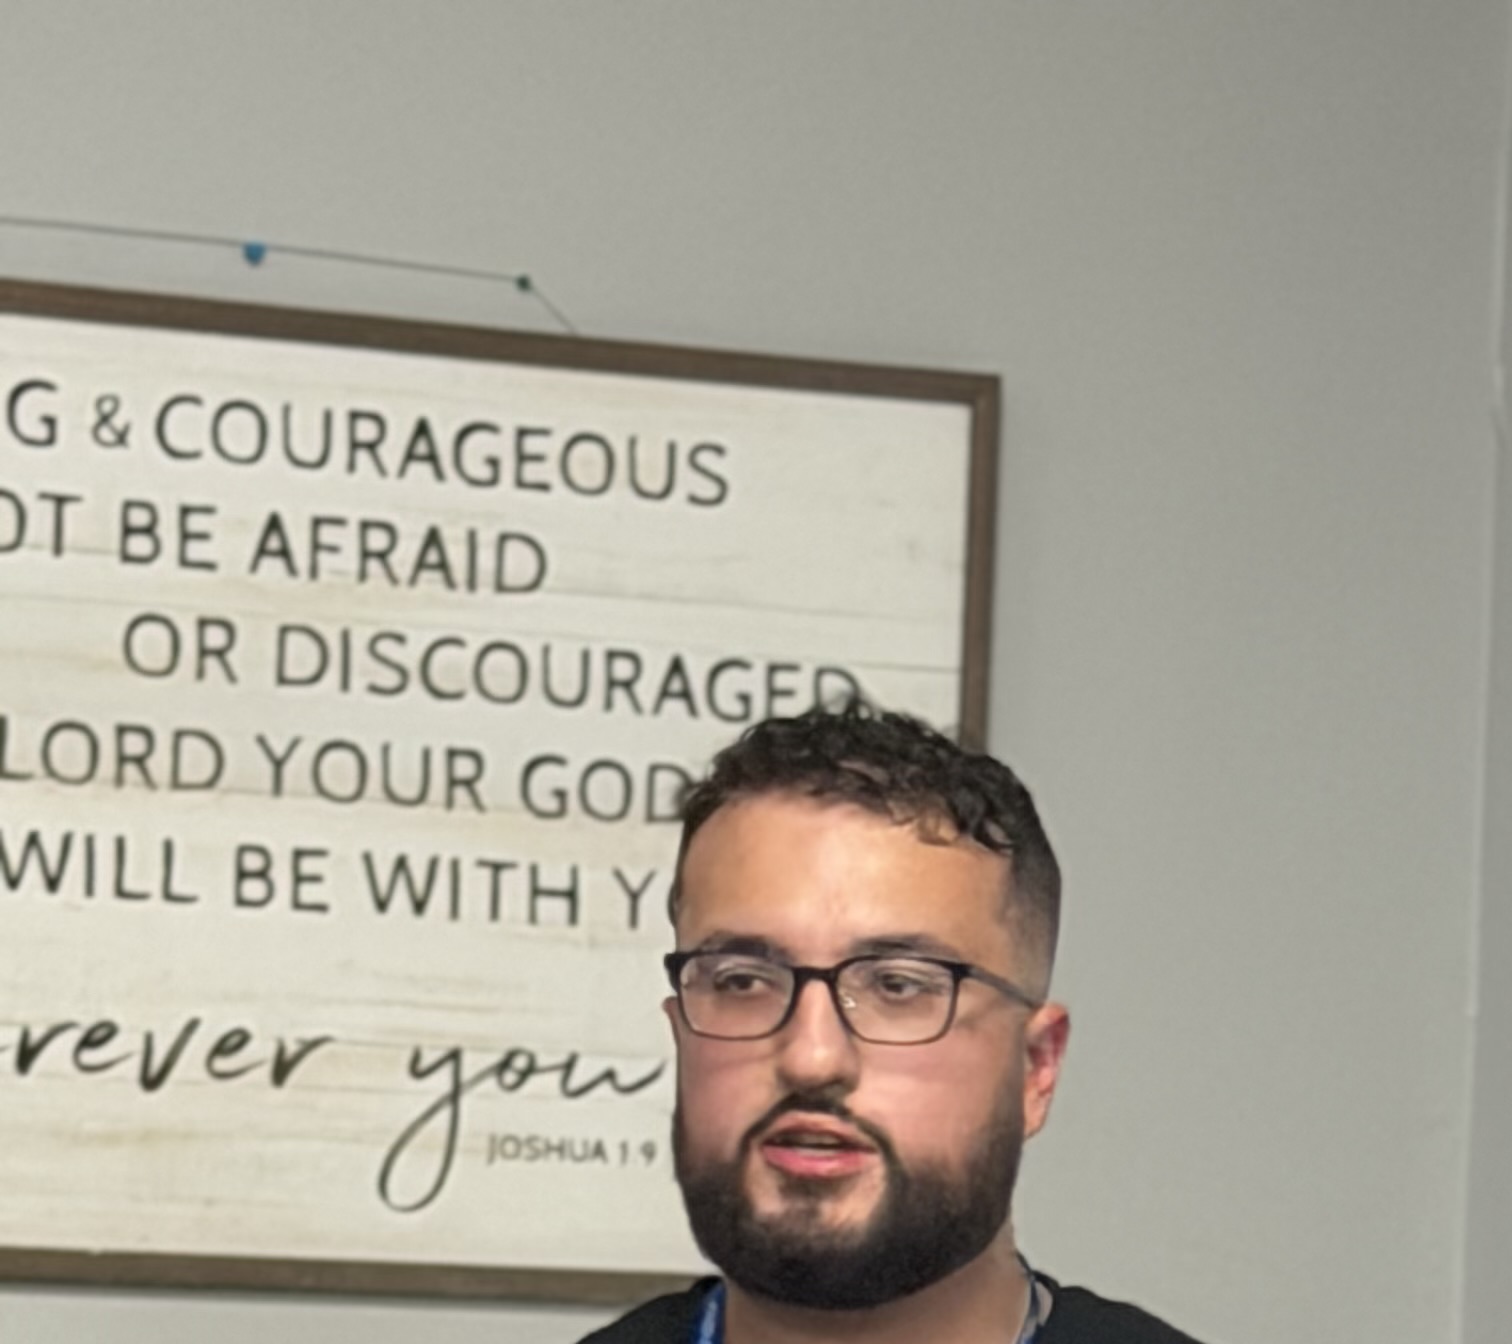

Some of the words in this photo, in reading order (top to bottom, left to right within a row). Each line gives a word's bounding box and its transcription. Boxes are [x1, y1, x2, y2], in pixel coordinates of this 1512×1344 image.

[91, 393, 131, 449] &
[154, 393, 729, 507] COURAGEOUS
[119, 498, 218, 572] BE
[248, 509, 547, 595] AFRAID
[122, 612, 238, 685] OR
[0, 713, 225, 792] LORD
[254, 732, 487, 812] YOUR
[519, 752, 690, 825] GOD
[0, 829, 200, 904] WILL
[233, 843, 330, 914] BE
[361, 850, 579, 927] WITH
[611, 865, 678, 930] Y
[377, 1045, 668, 1214] you
[485, 1132, 610, 1167] JOSHUA
